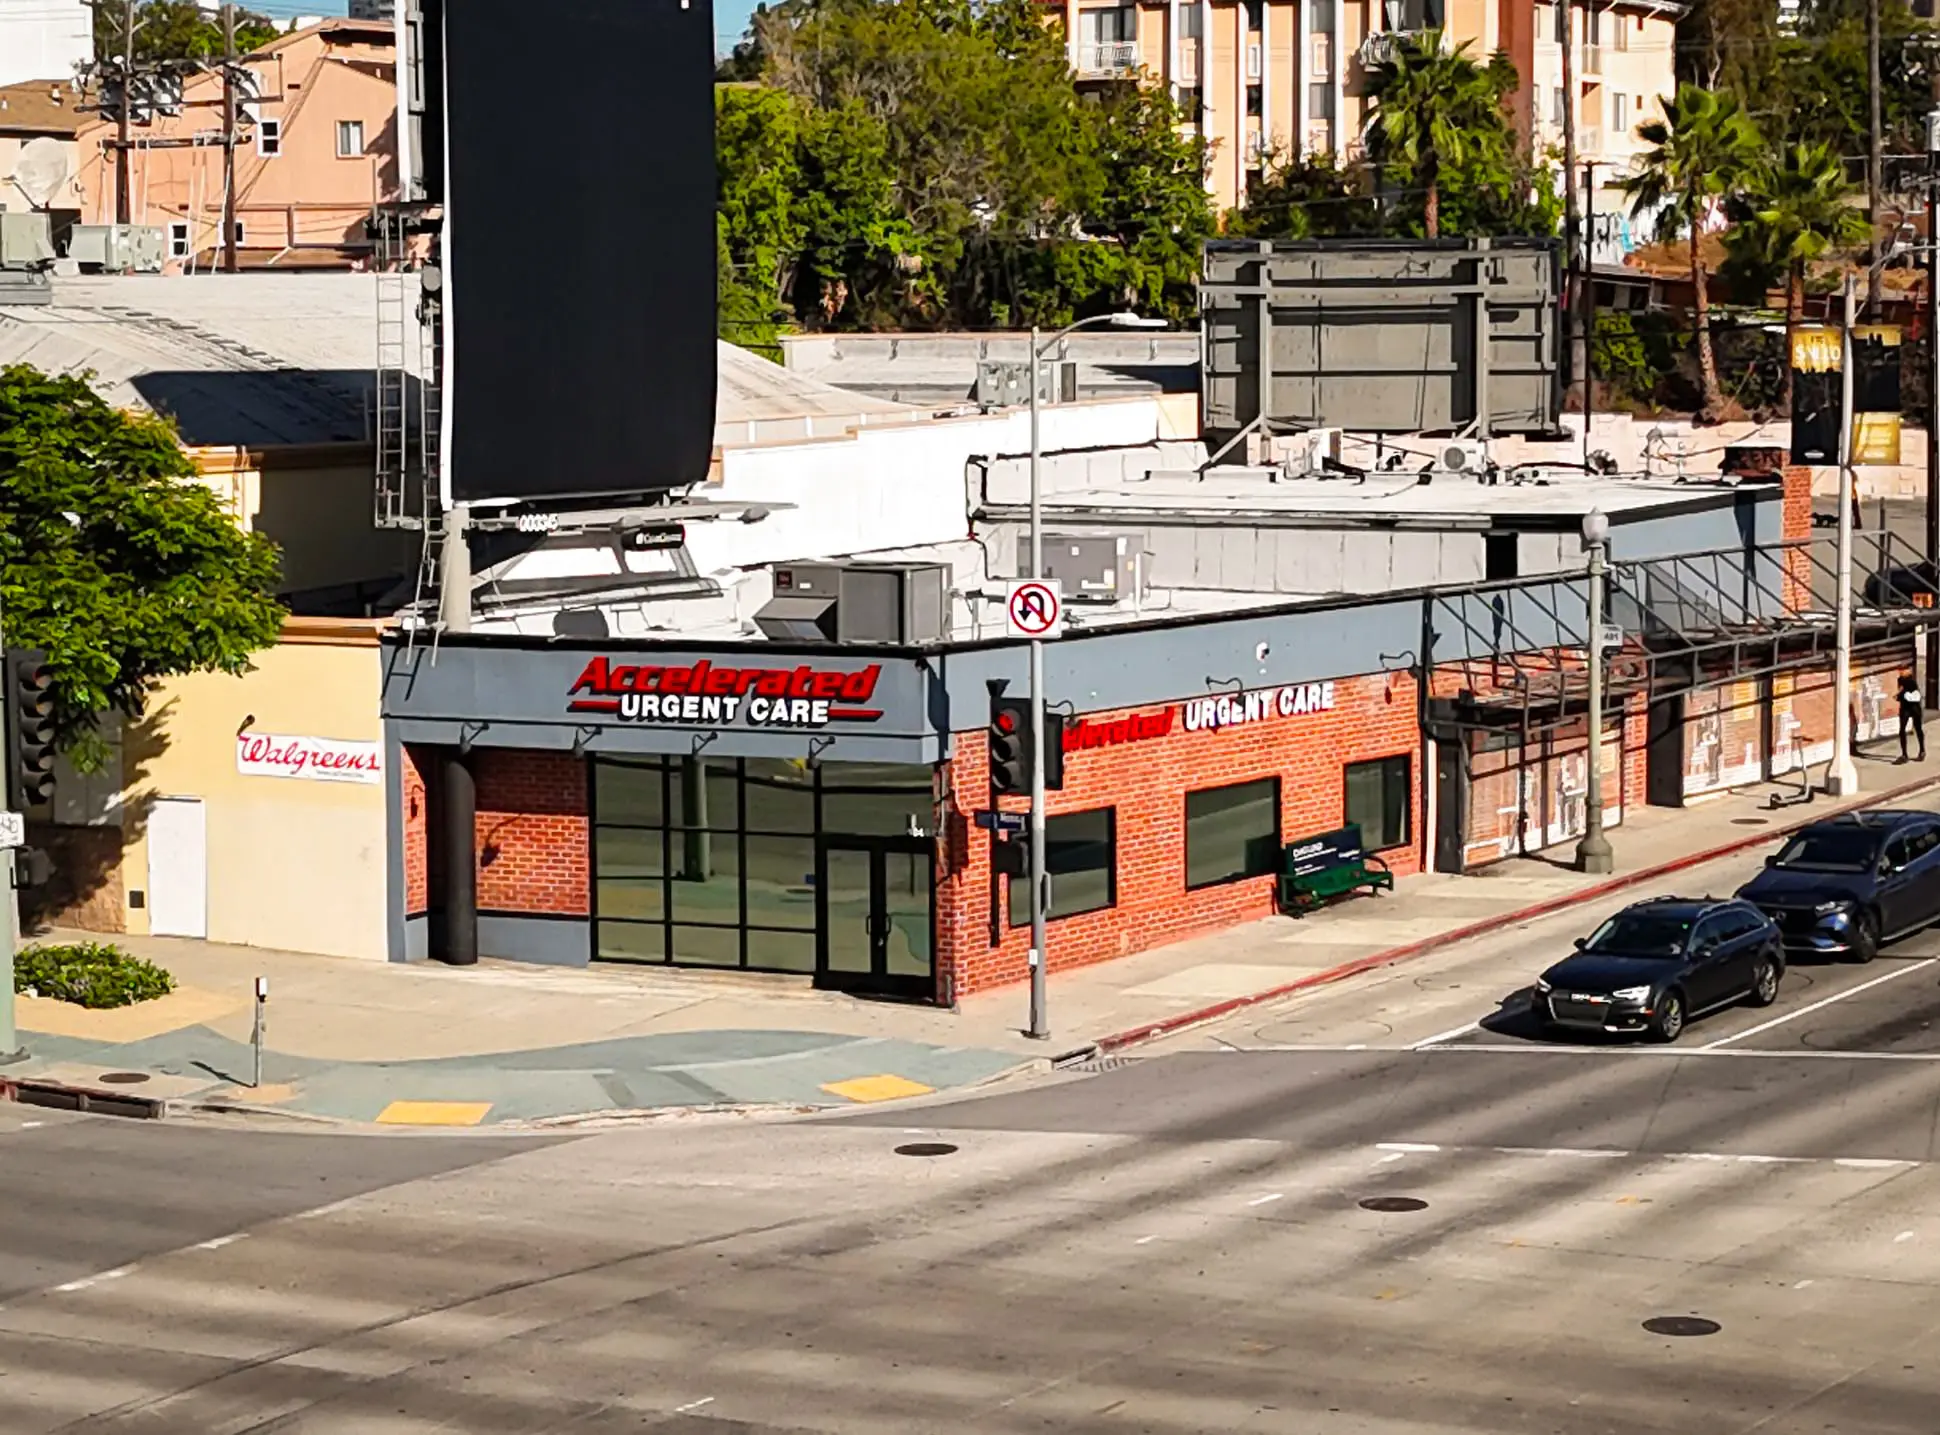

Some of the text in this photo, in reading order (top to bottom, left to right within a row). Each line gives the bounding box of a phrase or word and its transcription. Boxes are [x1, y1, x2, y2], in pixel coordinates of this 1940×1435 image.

[568, 656, 882, 702] Accelerated
[619, 694, 829, 724] URGENT CARE
[1184, 691, 1273, 732] URGENT
[1277, 681, 1335, 717] CARE
[238, 735, 381, 775] Walgreens
